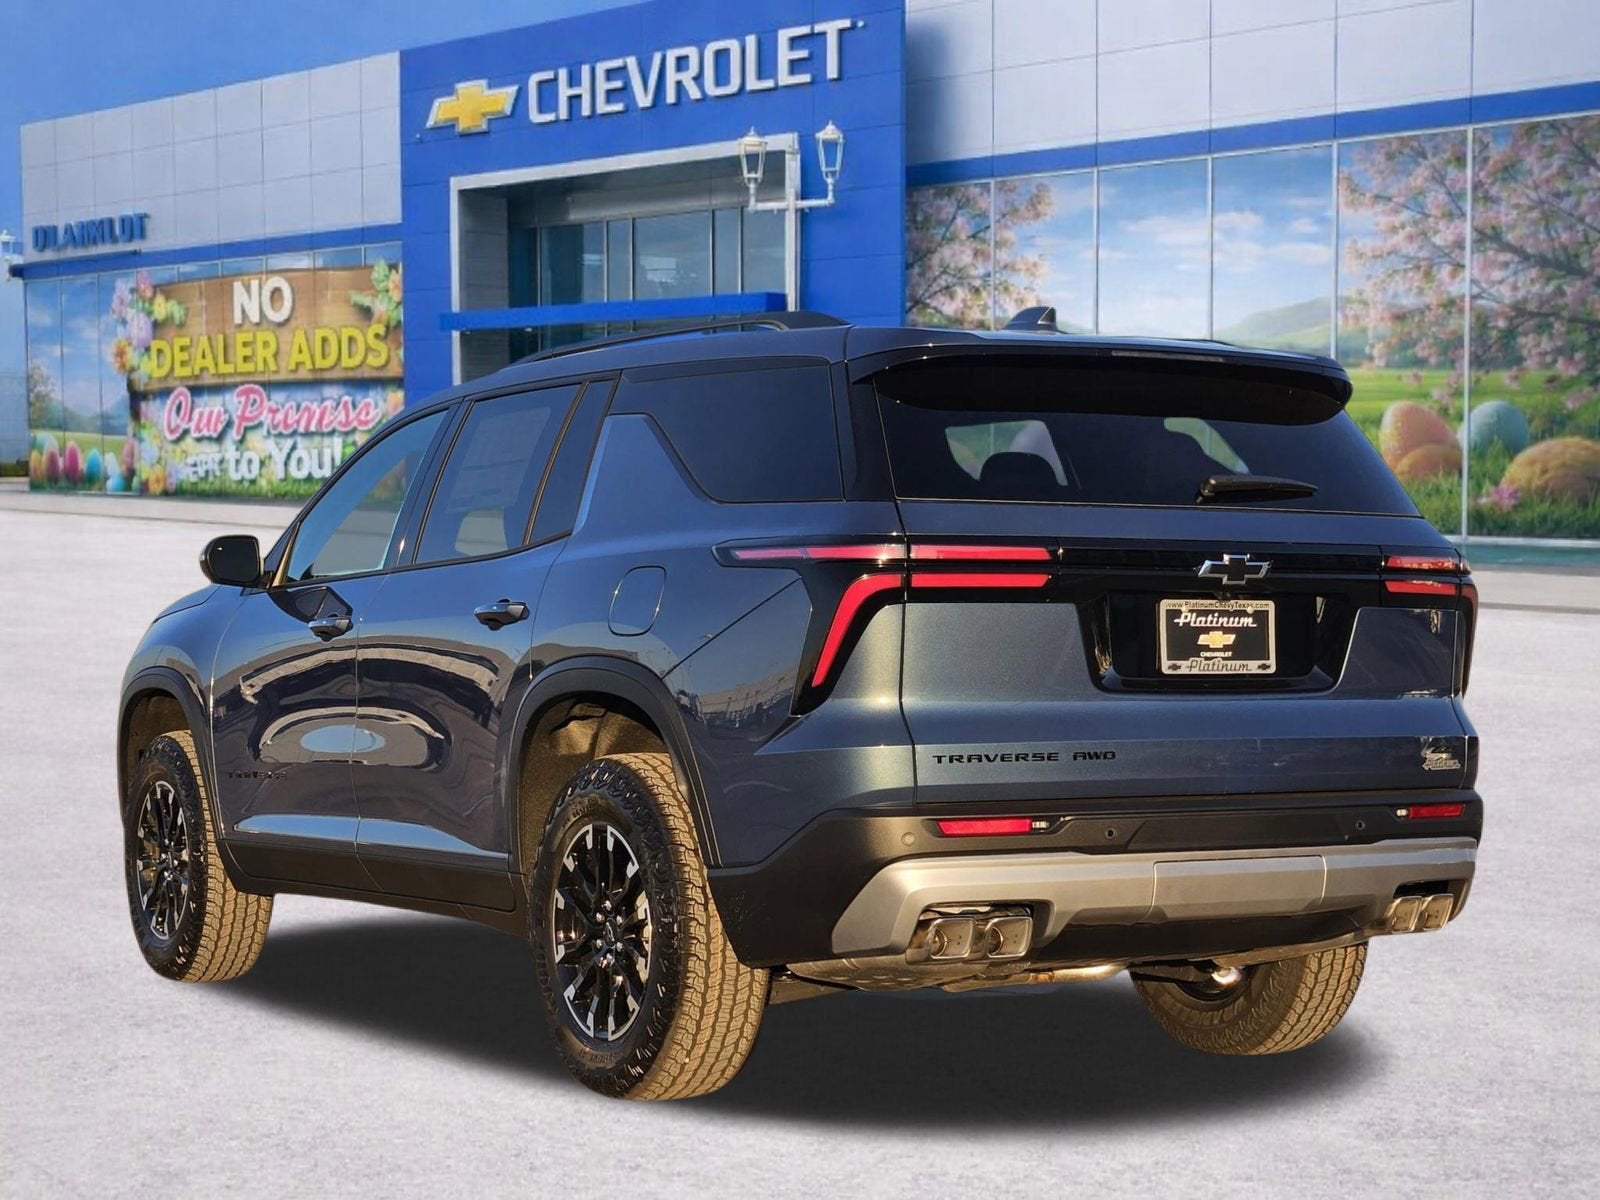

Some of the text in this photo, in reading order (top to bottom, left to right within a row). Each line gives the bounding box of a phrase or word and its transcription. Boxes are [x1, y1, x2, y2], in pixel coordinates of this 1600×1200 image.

[528, 18, 852, 124] CHEVROLET
[232, 276, 293, 325] NO
[150, 324, 390, 379] DEALER ADDS
[228, 446, 260, 480] to
[1174, 612, 1257, 627] Platinum
[1186, 659, 1252, 672] Platinum
[932, 751, 1116, 764] TRAVERSE AWD
